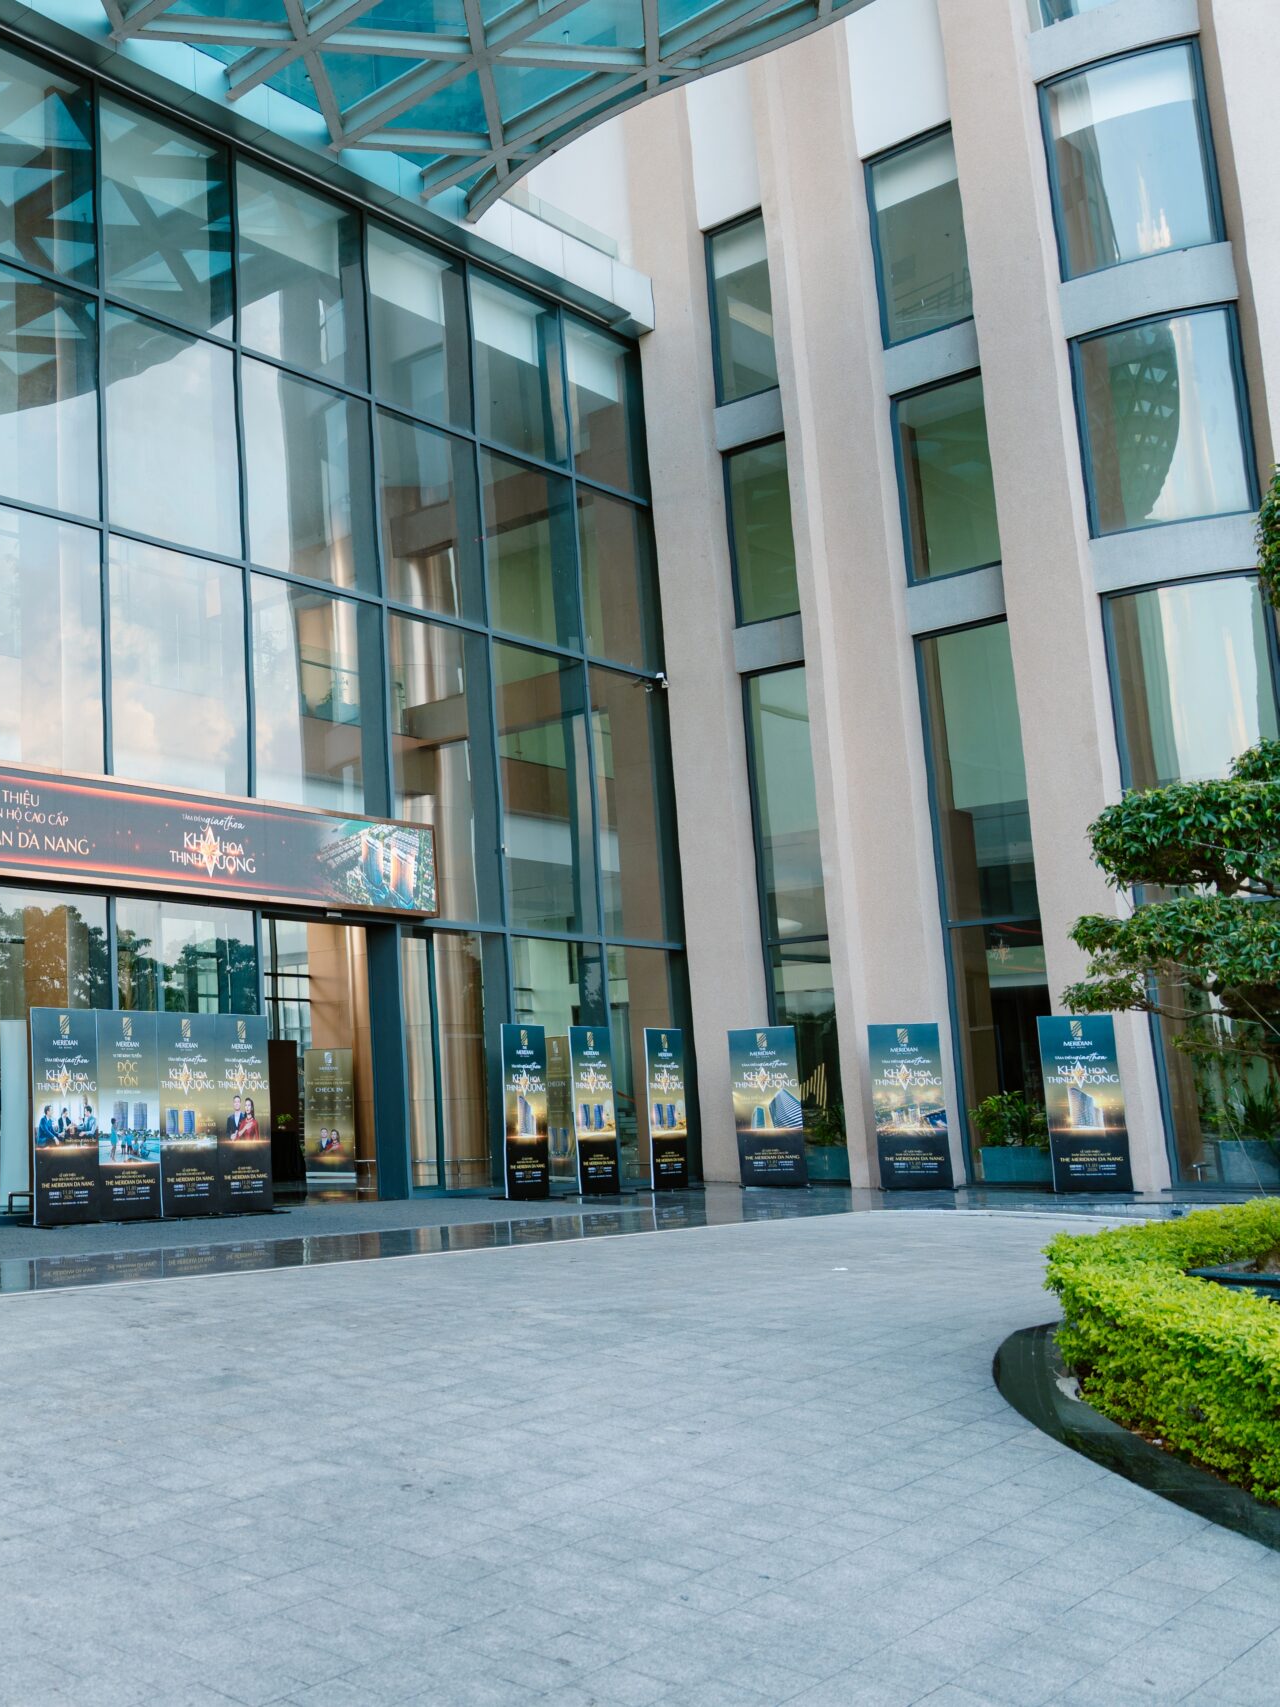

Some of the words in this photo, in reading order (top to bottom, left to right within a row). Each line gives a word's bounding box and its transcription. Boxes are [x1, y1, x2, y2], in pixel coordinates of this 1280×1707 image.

[2, 789, 40, 808] THIỆU
[6, 807, 22, 823] HỘ
[24, 811, 45, 825] CAO
[48, 811, 69, 827] CẤP
[18, 832, 40, 850] DA
[45, 836, 90, 856] NANG
[222, 841, 245, 855] HOA
[169, 850, 203, 866] THỊNH
[73, 1072, 89, 1080] HOA
